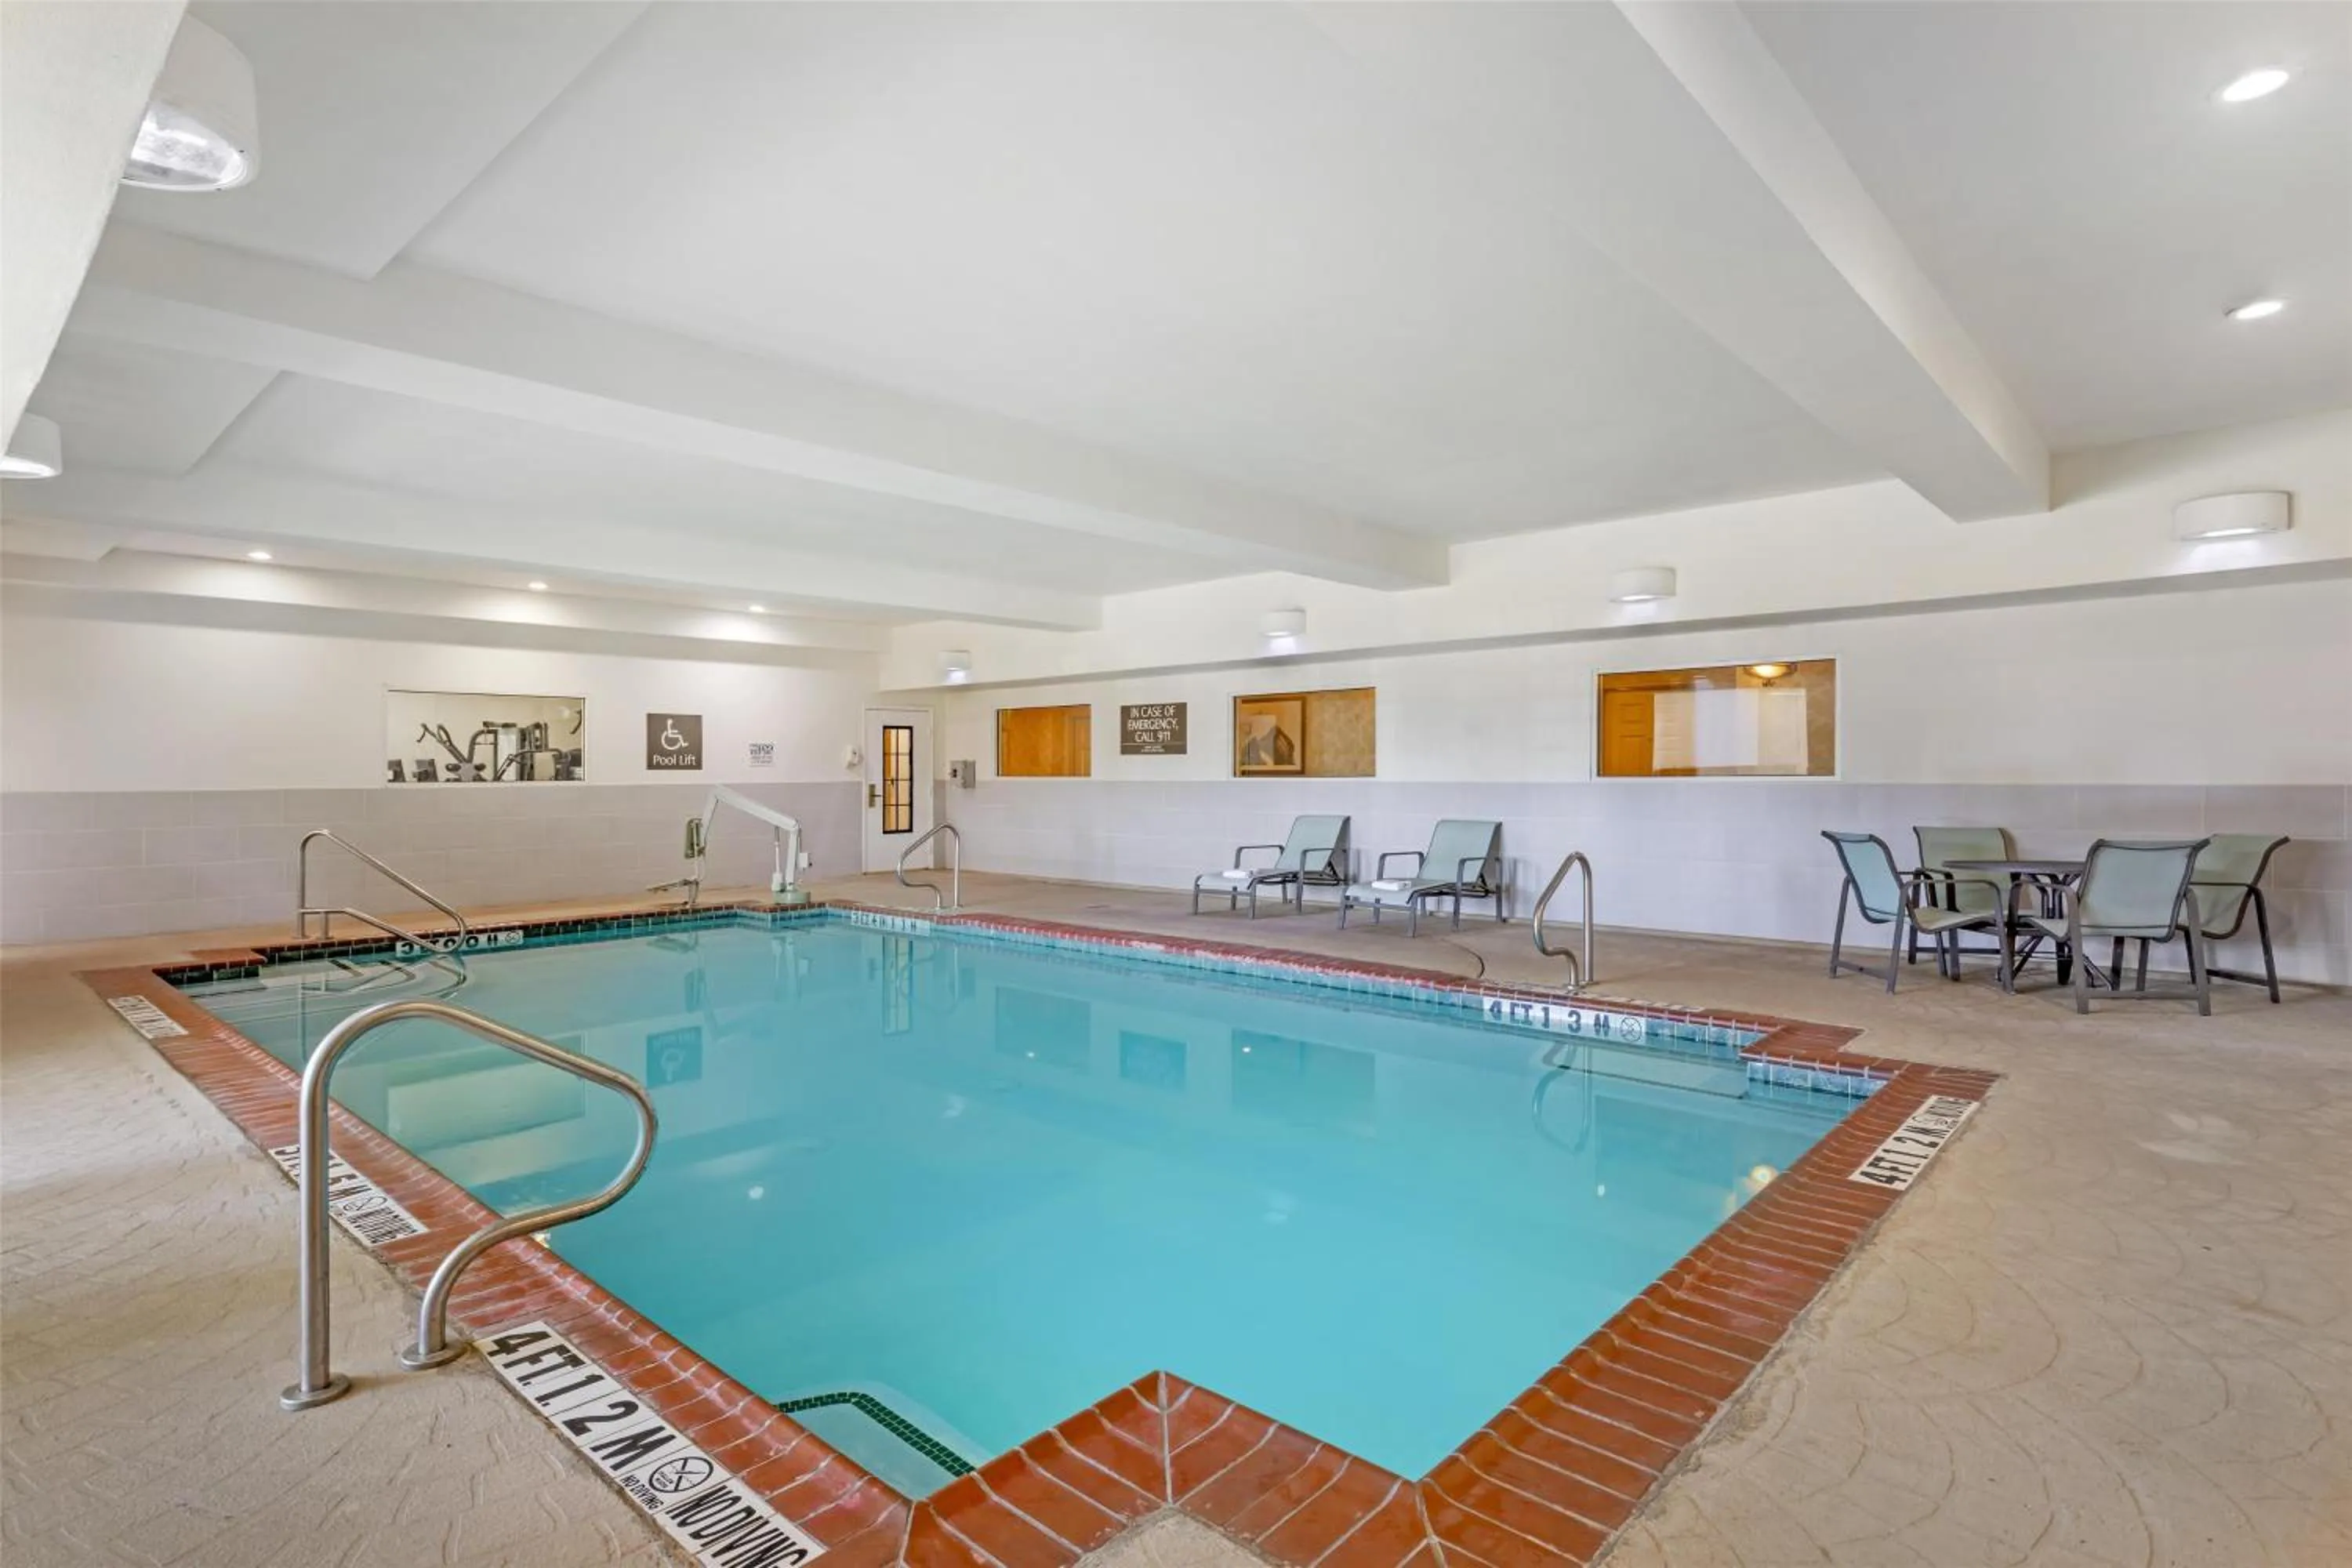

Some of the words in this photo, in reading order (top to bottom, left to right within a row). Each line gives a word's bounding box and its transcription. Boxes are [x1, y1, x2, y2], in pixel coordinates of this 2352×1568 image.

[1130, 707, 1139, 718] IN
[1141, 706, 1163, 717] CASE
[1164, 706, 1176, 717] OF
[1134, 731, 1155, 742] CALL
[1156, 731, 1171, 742] 911
[653, 753, 677, 766] Pool
[679, 753, 695, 766] Lift
[620, 1475, 641, 1487] NO
[665, 1484, 742, 1527] NO
